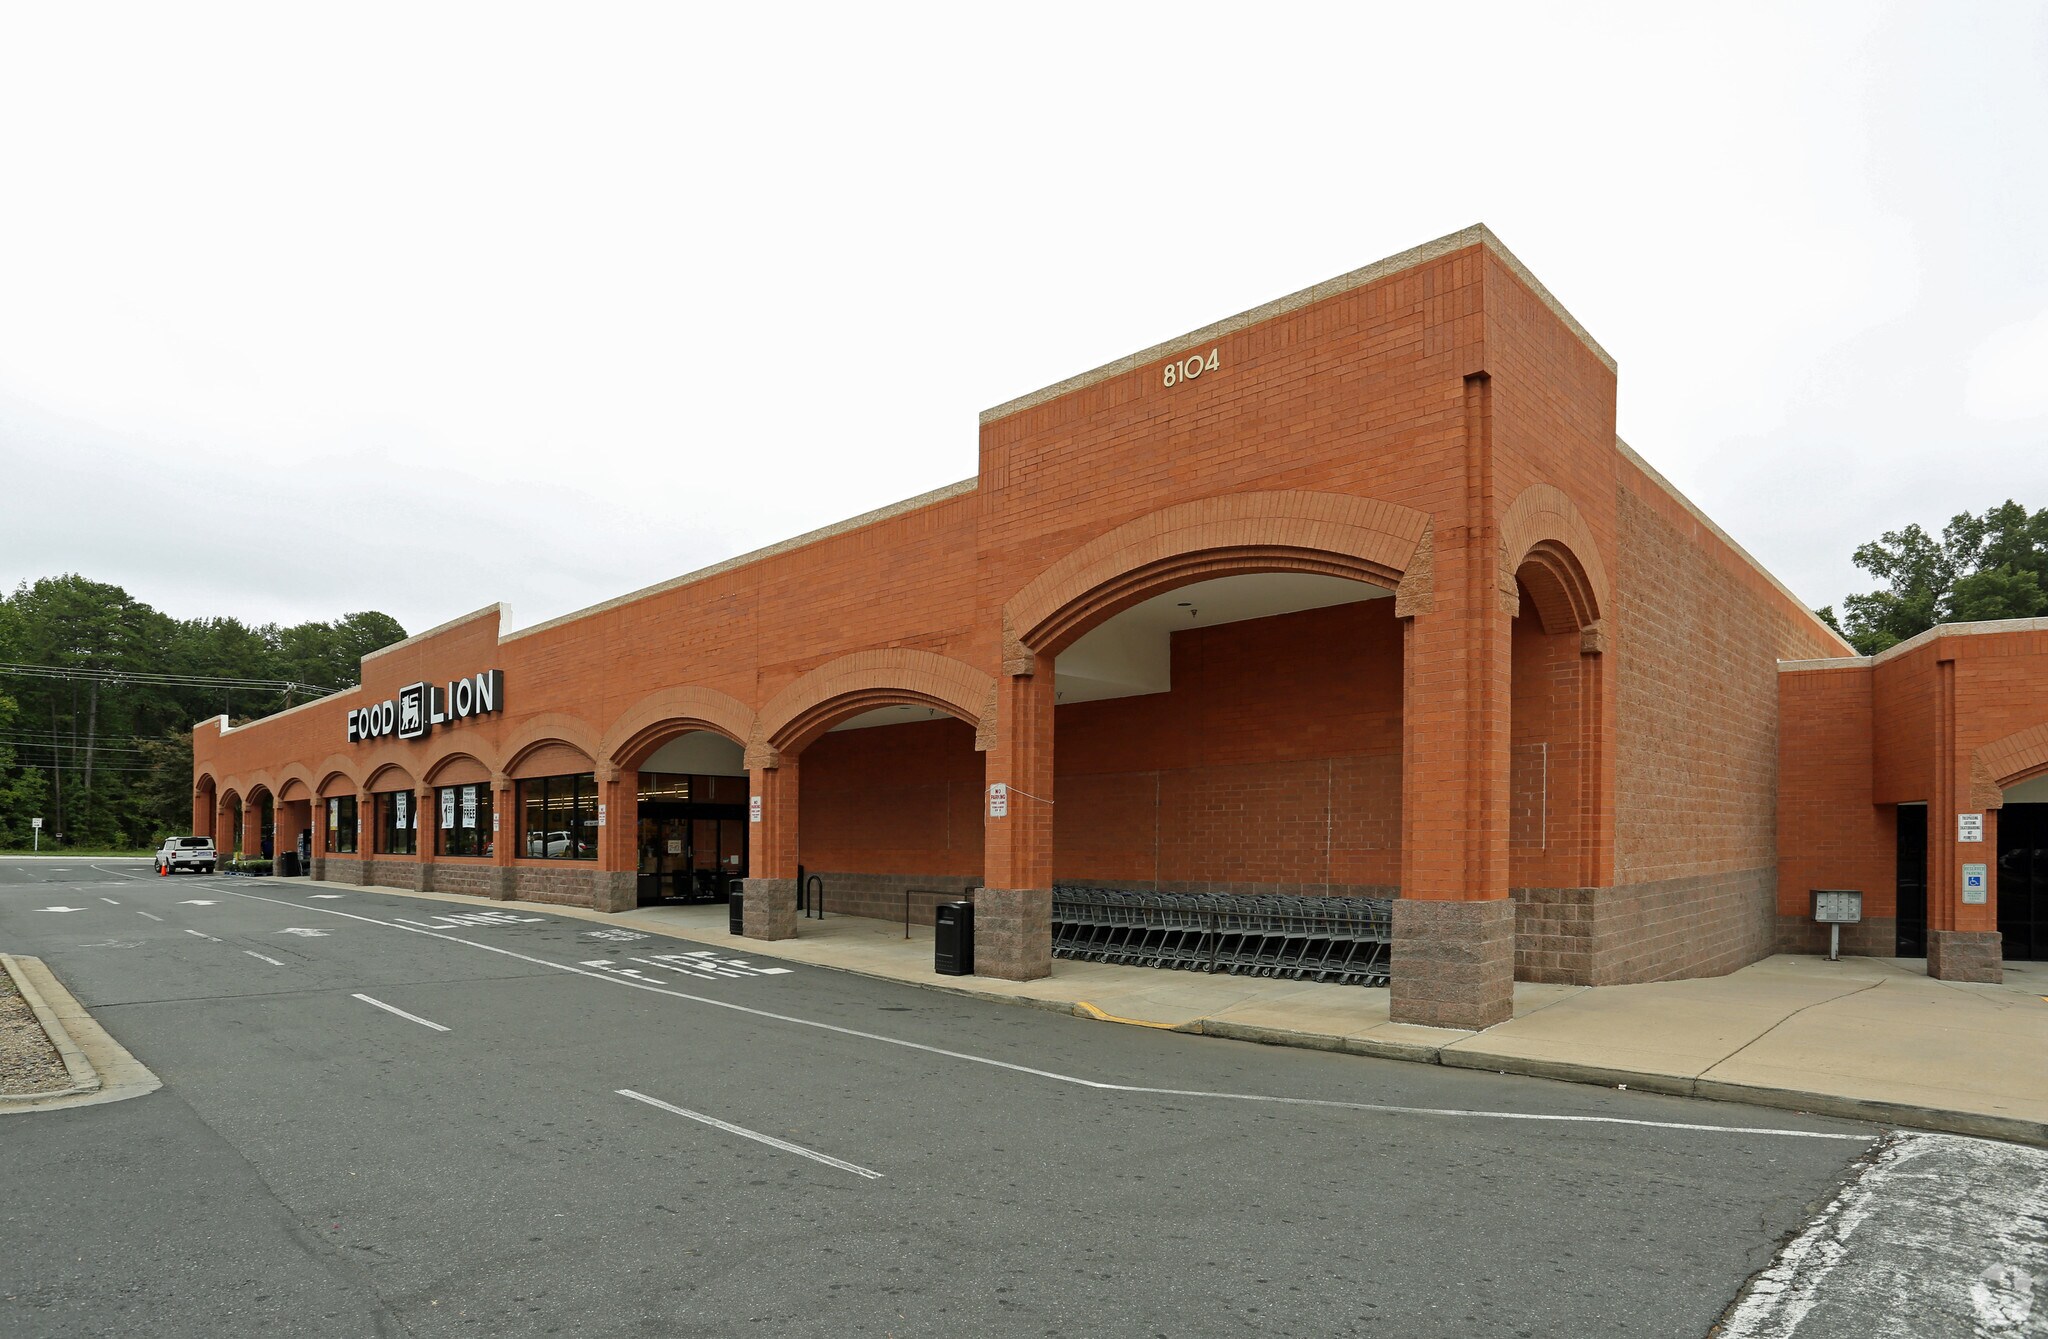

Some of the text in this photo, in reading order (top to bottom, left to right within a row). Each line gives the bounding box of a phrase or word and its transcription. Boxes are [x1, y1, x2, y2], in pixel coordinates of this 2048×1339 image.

[1163, 348, 1220, 387] 8104
[348, 669, 495, 742] FOOD LION
[578, 951, 796, 985] FIRE
